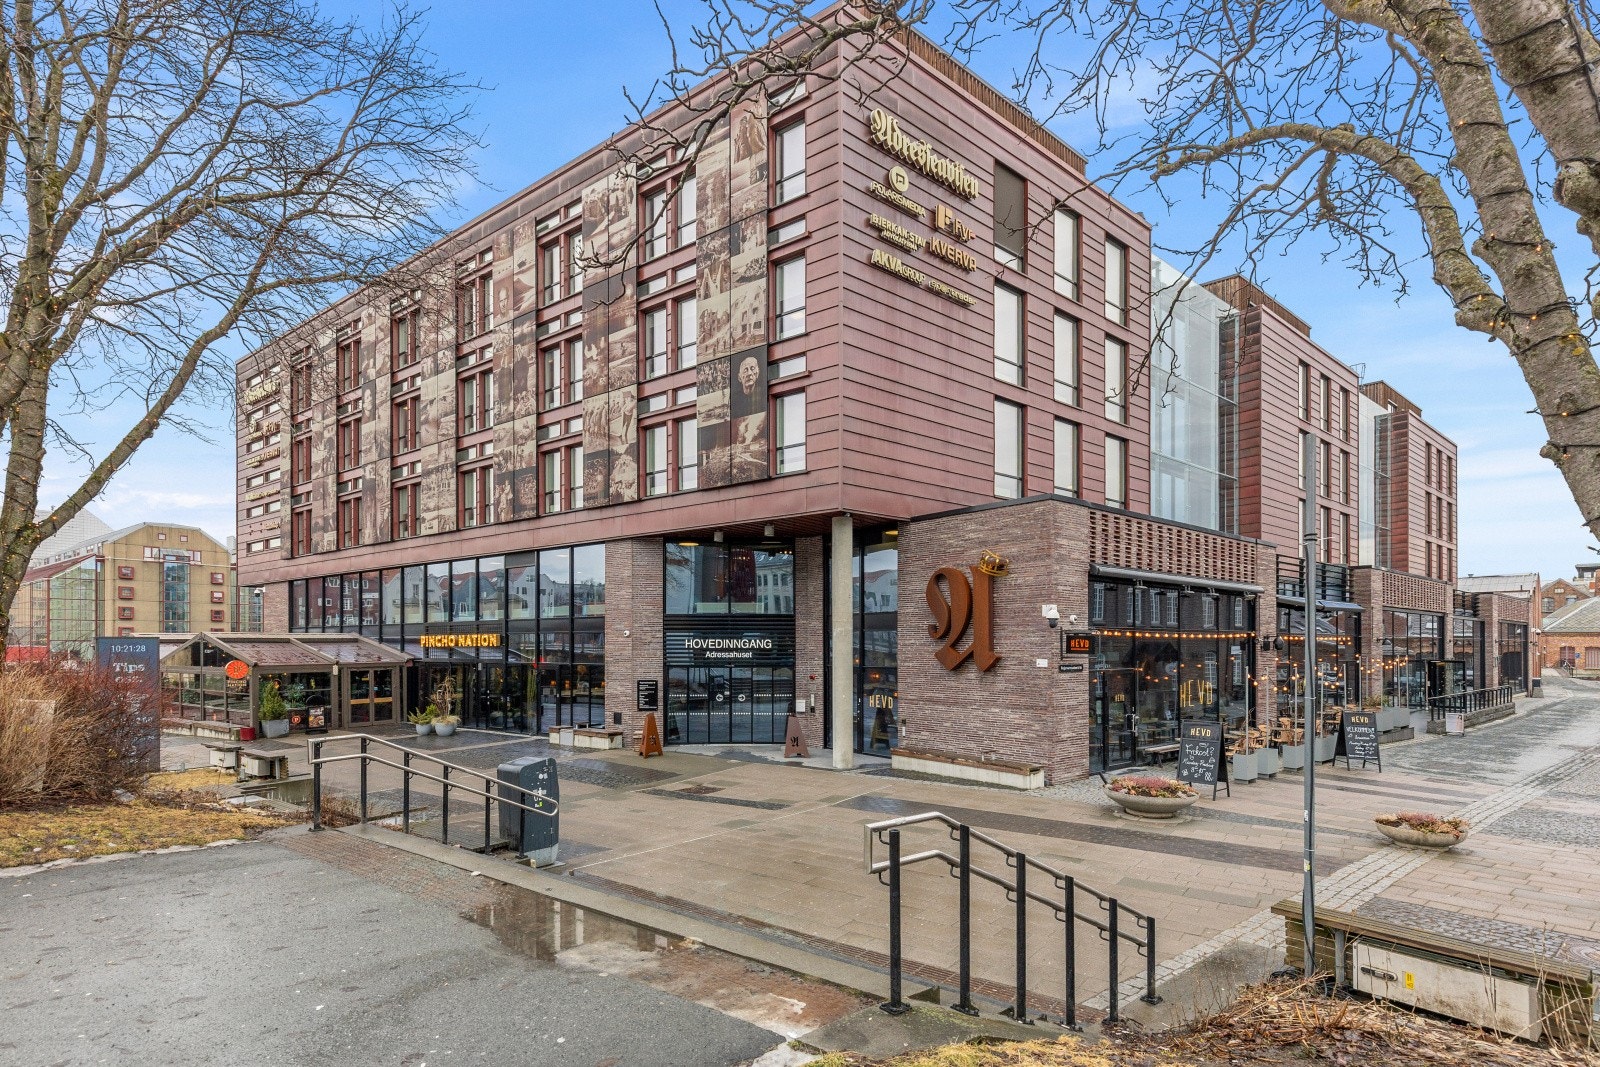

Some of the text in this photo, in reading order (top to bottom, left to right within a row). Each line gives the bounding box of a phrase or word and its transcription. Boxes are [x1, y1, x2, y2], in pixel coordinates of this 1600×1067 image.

[420, 634, 498, 648] PINCHO NATION
[685, 639, 772, 649] HOVEDINNGANG
[1070, 639, 1090, 648] HEVD
[111, 645, 146, 653] 10:21:28
[869, 694, 893, 710] HEVD
[1190, 727, 1211, 737] HEVD
